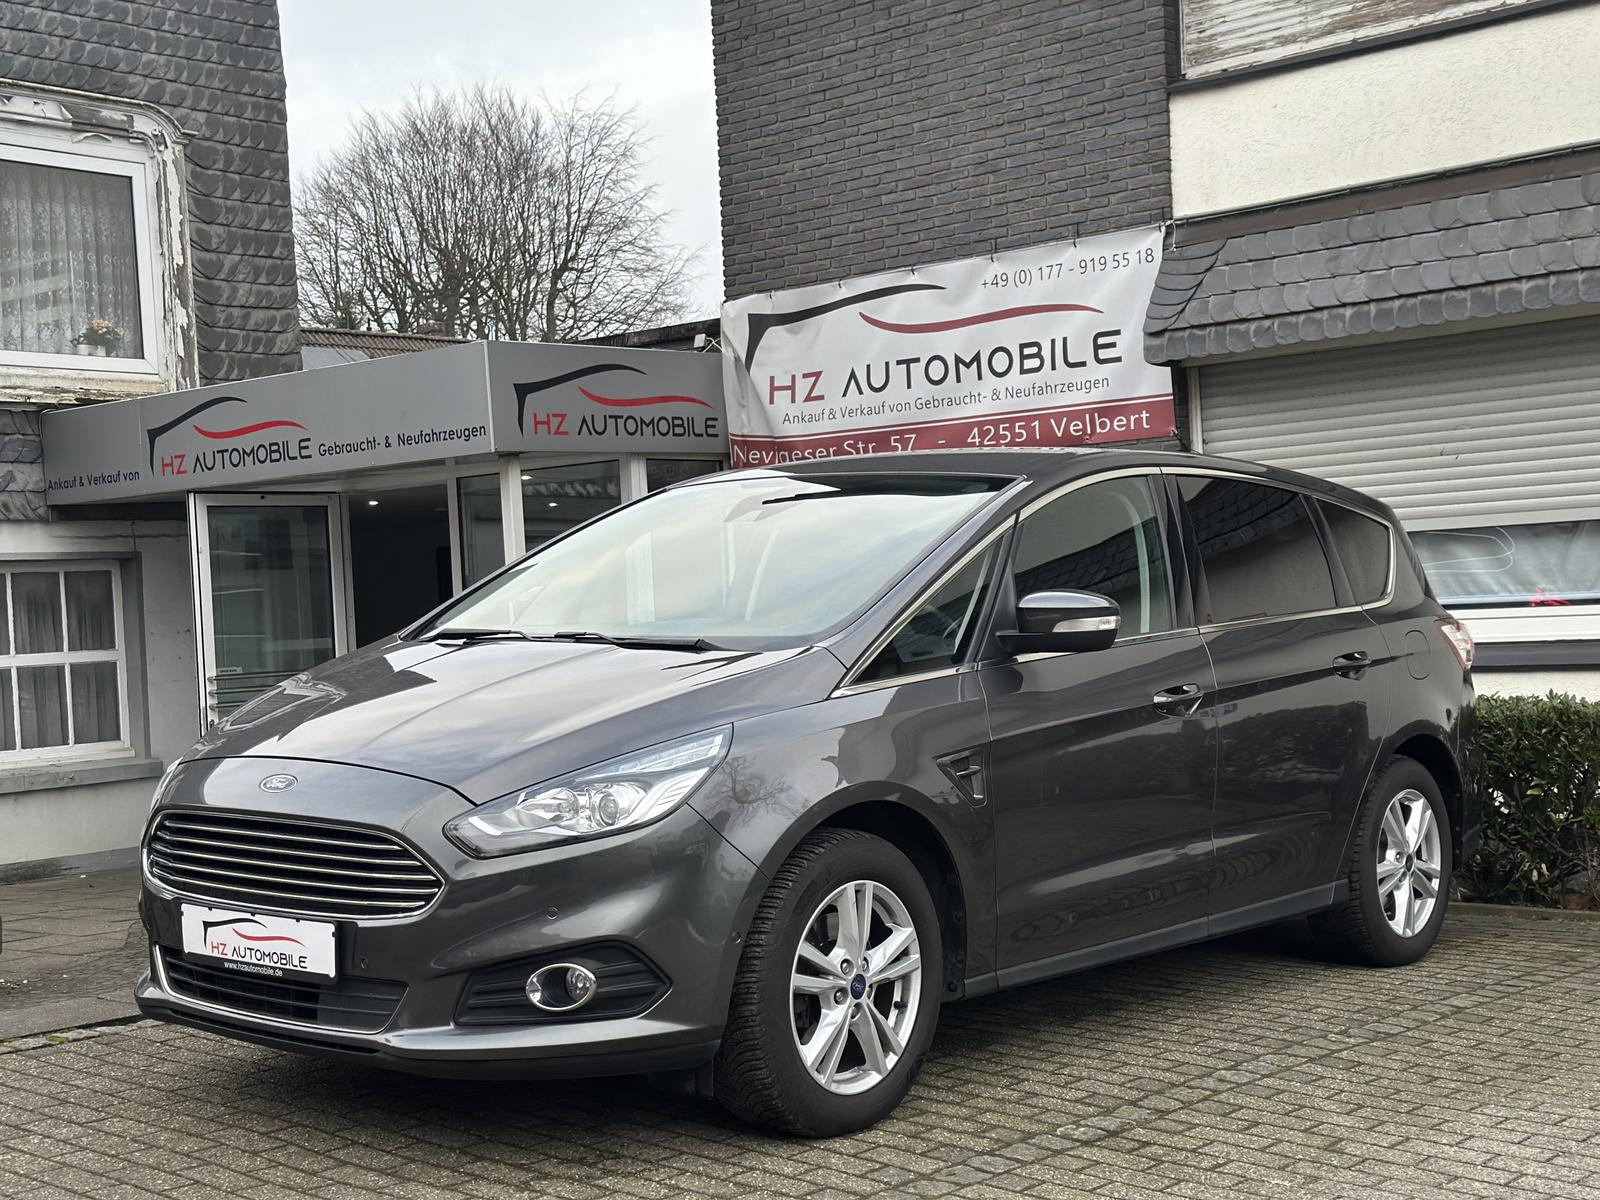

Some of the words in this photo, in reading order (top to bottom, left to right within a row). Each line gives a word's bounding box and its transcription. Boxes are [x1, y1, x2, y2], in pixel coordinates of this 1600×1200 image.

[981, 272, 1009, 289] +49
[1013, 268, 1032, 288] (0)
[1038, 263, 1063, 281] 177
[1079, 255, 1107, 275] 919
[1112, 251, 1130, 270] 55
[1136, 247, 1155, 265] 18
[768, 370, 825, 406] HZ
[841, 329, 1122, 398] AUTOMOBILE
[782, 411, 825, 425] Ankauf
[827, 408, 837, 420] &
[840, 401, 886, 419] Verkauf
[888, 400, 911, 414] von
[914, 391, 987, 412] Gebraucht-
[991, 388, 1002, 402] &
[1005, 377, 1110, 400] Neufahrzeugen
[318, 436, 381, 457] Gebraucht-
[384, 435, 392, 448] &
[397, 425, 487, 448] Neufahrzeugen
[533, 412, 569, 436] HZ
[577, 414, 719, 438] AUTOMOBILE
[890, 433, 917, 452] 57
[966, 419, 1041, 446] 42551
[1050, 409, 1150, 438] Velbert
[161, 453, 187, 477] HZ
[192, 437, 312, 474] AUTOMOBILE
[47, 475, 77, 492] Ankauf
[78, 476, 85, 488] &
[87, 470, 121, 487] Verkauf
[123, 470, 140, 482] von
[210, 941, 228, 956] HZ
[231, 945, 308, 970] AUTOMOBILE
[223, 961, 283, 977] www.hzautomobile.de
